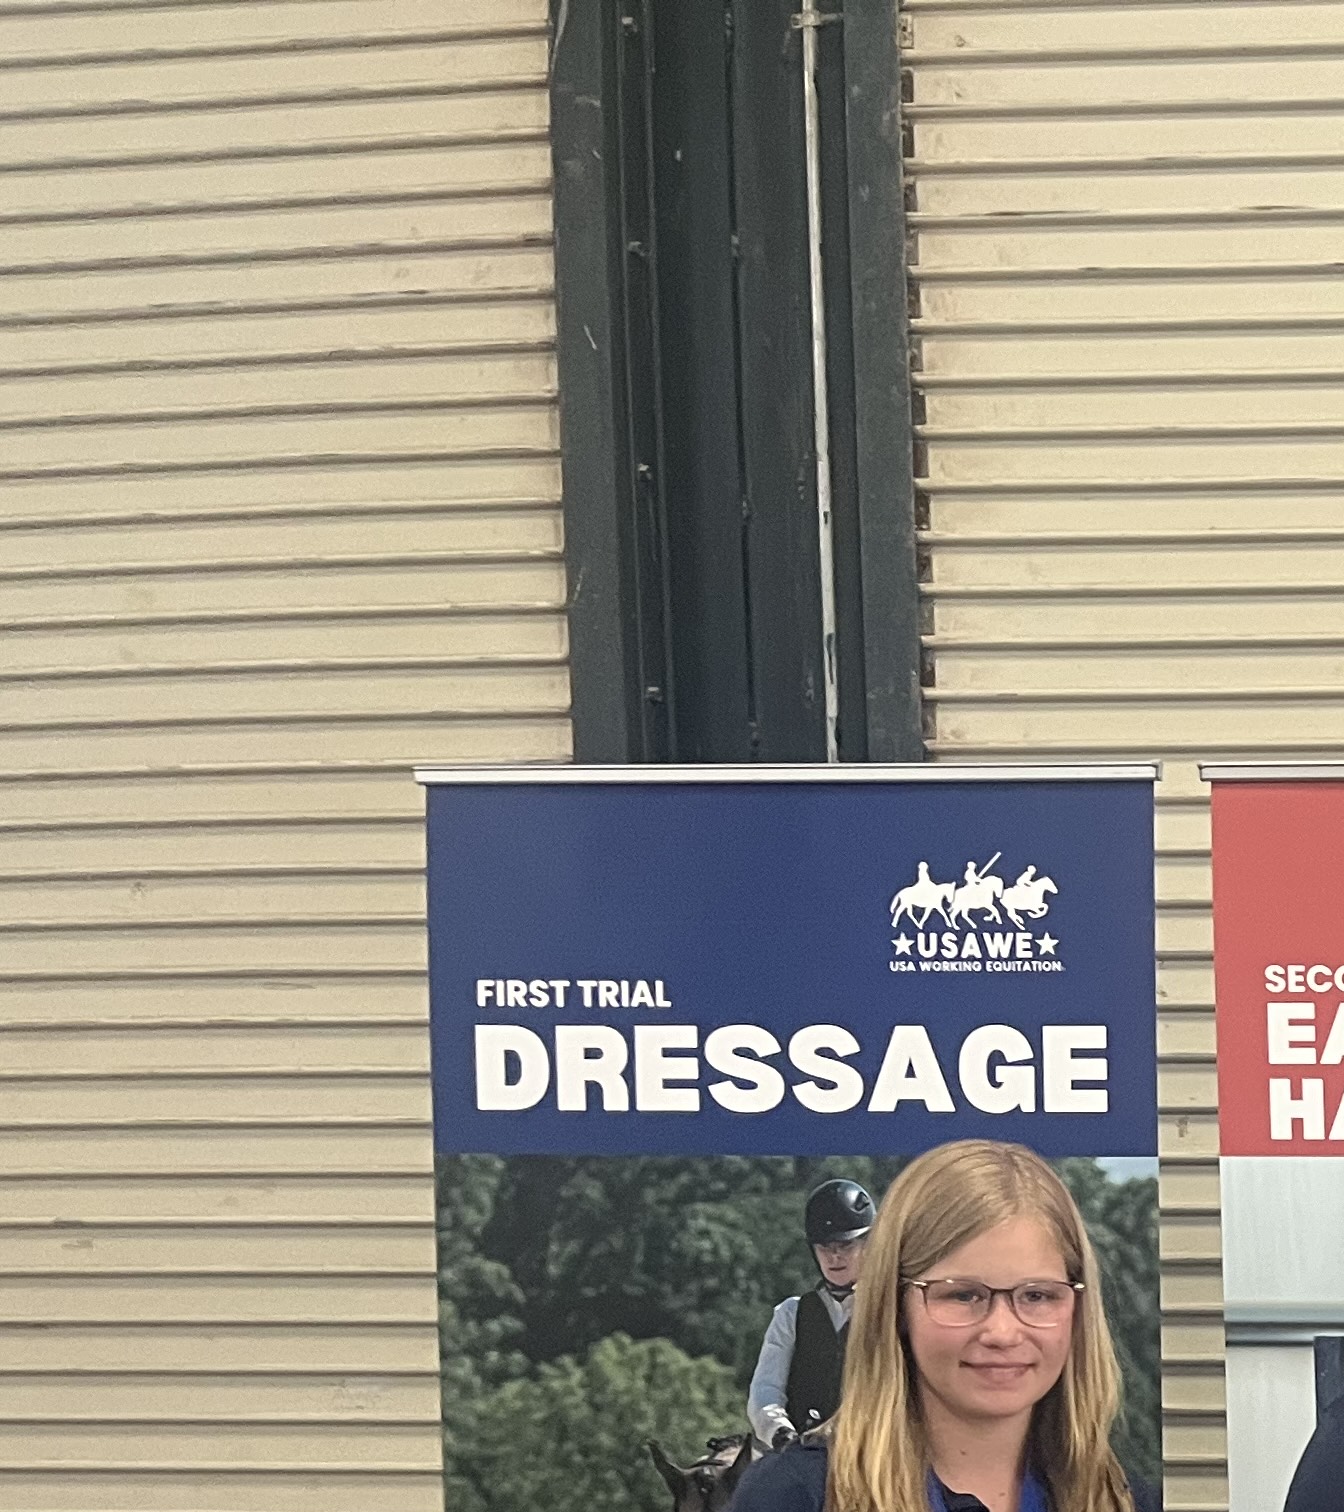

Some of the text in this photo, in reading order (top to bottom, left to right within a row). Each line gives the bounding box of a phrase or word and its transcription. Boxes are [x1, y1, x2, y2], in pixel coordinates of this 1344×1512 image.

[918, 931, 1034, 960] USAWE
[890, 961, 1061, 973] USA WORKING EQUITATION
[476, 979, 672, 1009] FIRST TRIAL
[474, 1024, 1110, 1114] DRESSAGE
